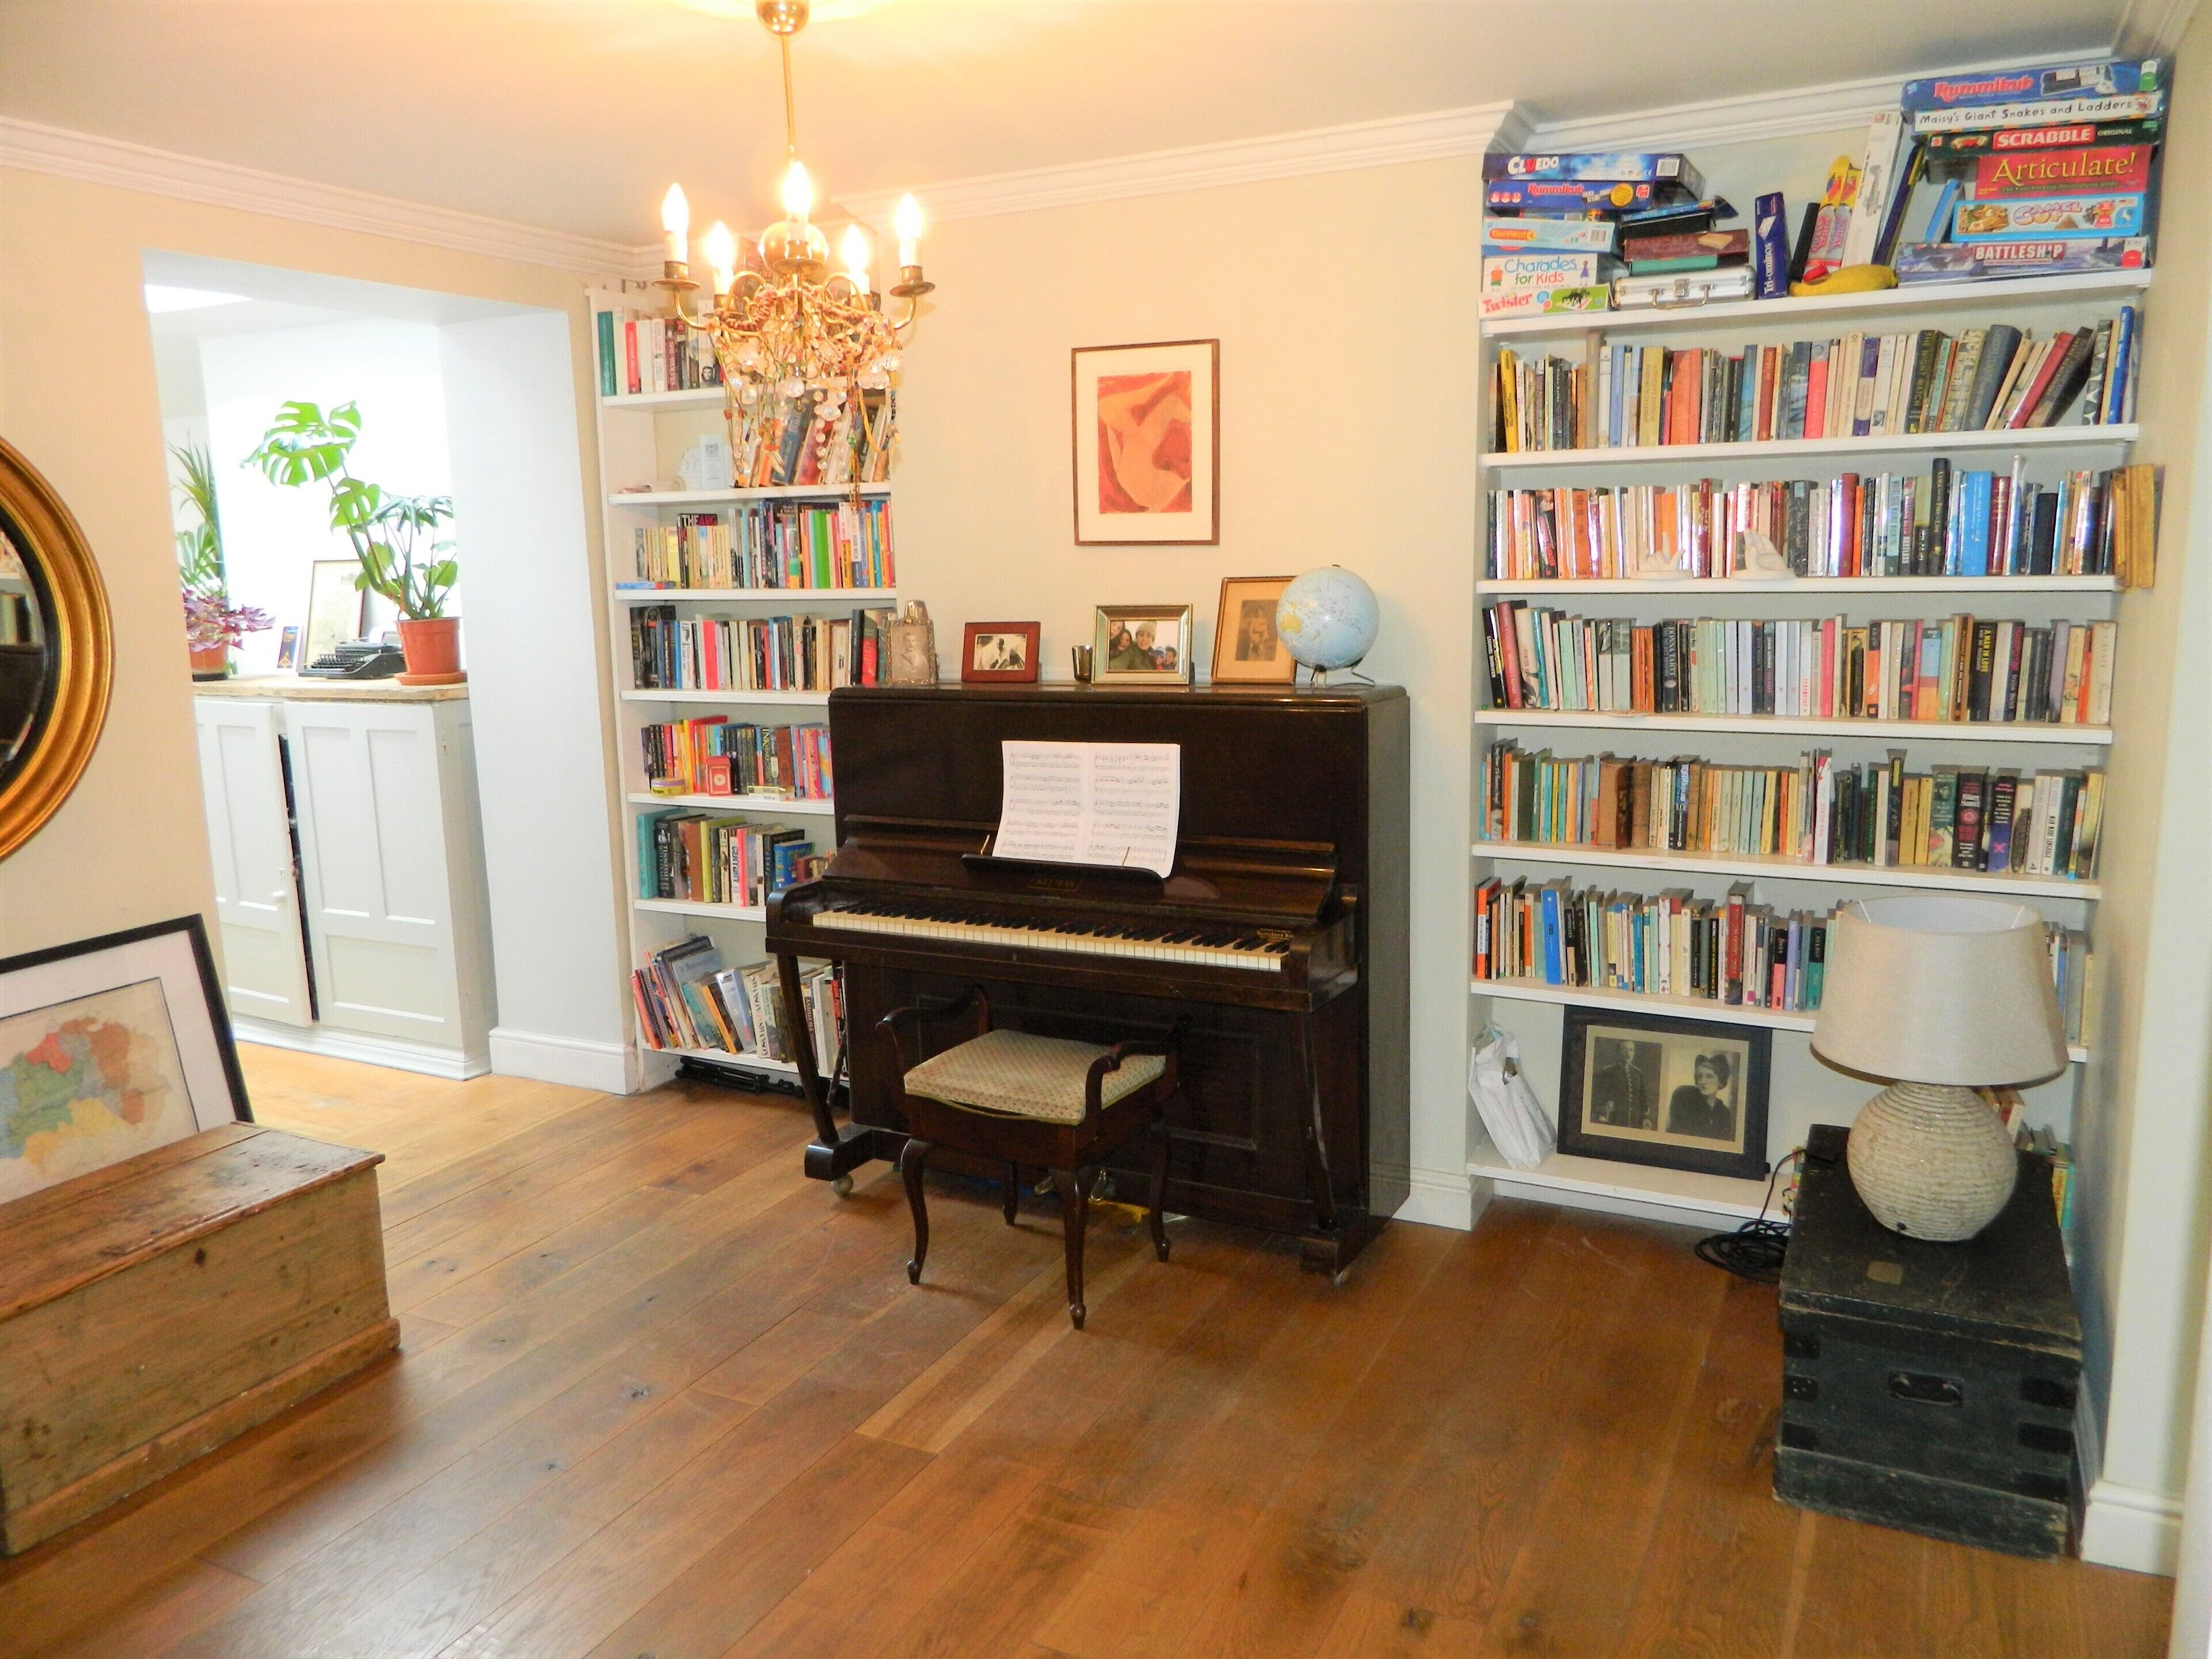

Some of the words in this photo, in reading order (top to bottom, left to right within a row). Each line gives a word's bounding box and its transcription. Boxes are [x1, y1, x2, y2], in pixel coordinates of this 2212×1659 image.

[1934, 75, 2034, 103] Rummikub
[1920, 112, 1959, 124] Maisy's
[1965, 110, 1995, 120] Giant
[2002, 108, 2044, 119] Snakes
[2051, 104, 2071, 114] and
[2078, 100, 2131, 112] Ladders
[1997, 128, 2090, 147] SCRABBLE
[2097, 128, 2131, 137] ORIGINAL
[1508, 156, 1559, 175] CLUEDO
[1991, 152, 2136, 186] Articulate!
[1528, 183, 1583, 197] Rummikub
[1975, 244, 2064, 260] BATTLESHIP
[1505, 257, 1577, 273] Charades
[1515, 272, 1533, 285] for
[1483, 293, 1532, 313] Twister
[1922, 332, 1931, 347] THE
[1919, 350, 1929, 376] NIGHT
[1902, 536, 1910, 564] RESTLESS
[1980, 658, 1988, 672] LOVE
[2044, 839, 2053, 858] LANGUAGE
